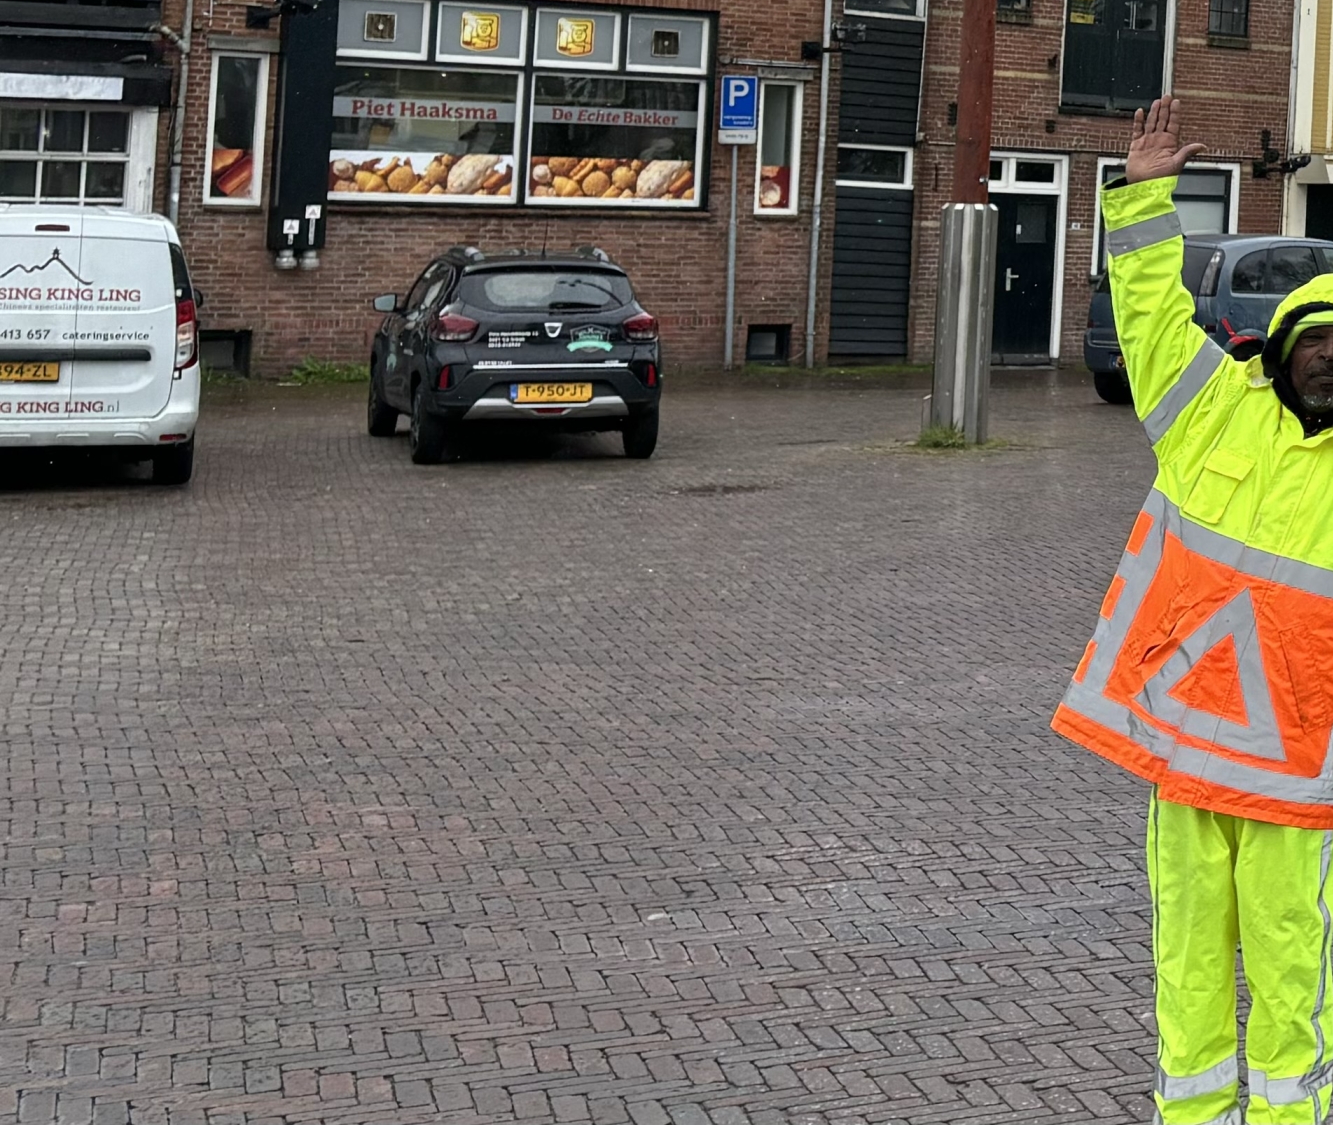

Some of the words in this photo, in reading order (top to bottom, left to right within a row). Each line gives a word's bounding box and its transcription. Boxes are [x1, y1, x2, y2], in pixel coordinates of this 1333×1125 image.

[728, 79, 750, 107] P
[351, 99, 395, 117] Piet
[399, 101, 498, 121] Haaksma
[551, 107, 573, 121] De
[577, 108, 621, 124] Echte
[623, 110, 680, 126] Bakker
[46, 287, 94, 302] KING
[98, 288, 142, 303] LING
[26, 328, 51, 341] 657
[62, 330, 150, 342] cateringservice
[0, 363, 52, 378] 94-ZL
[523, 384, 587, 398] T-950-JT
[16, 401, 60, 414] KING
